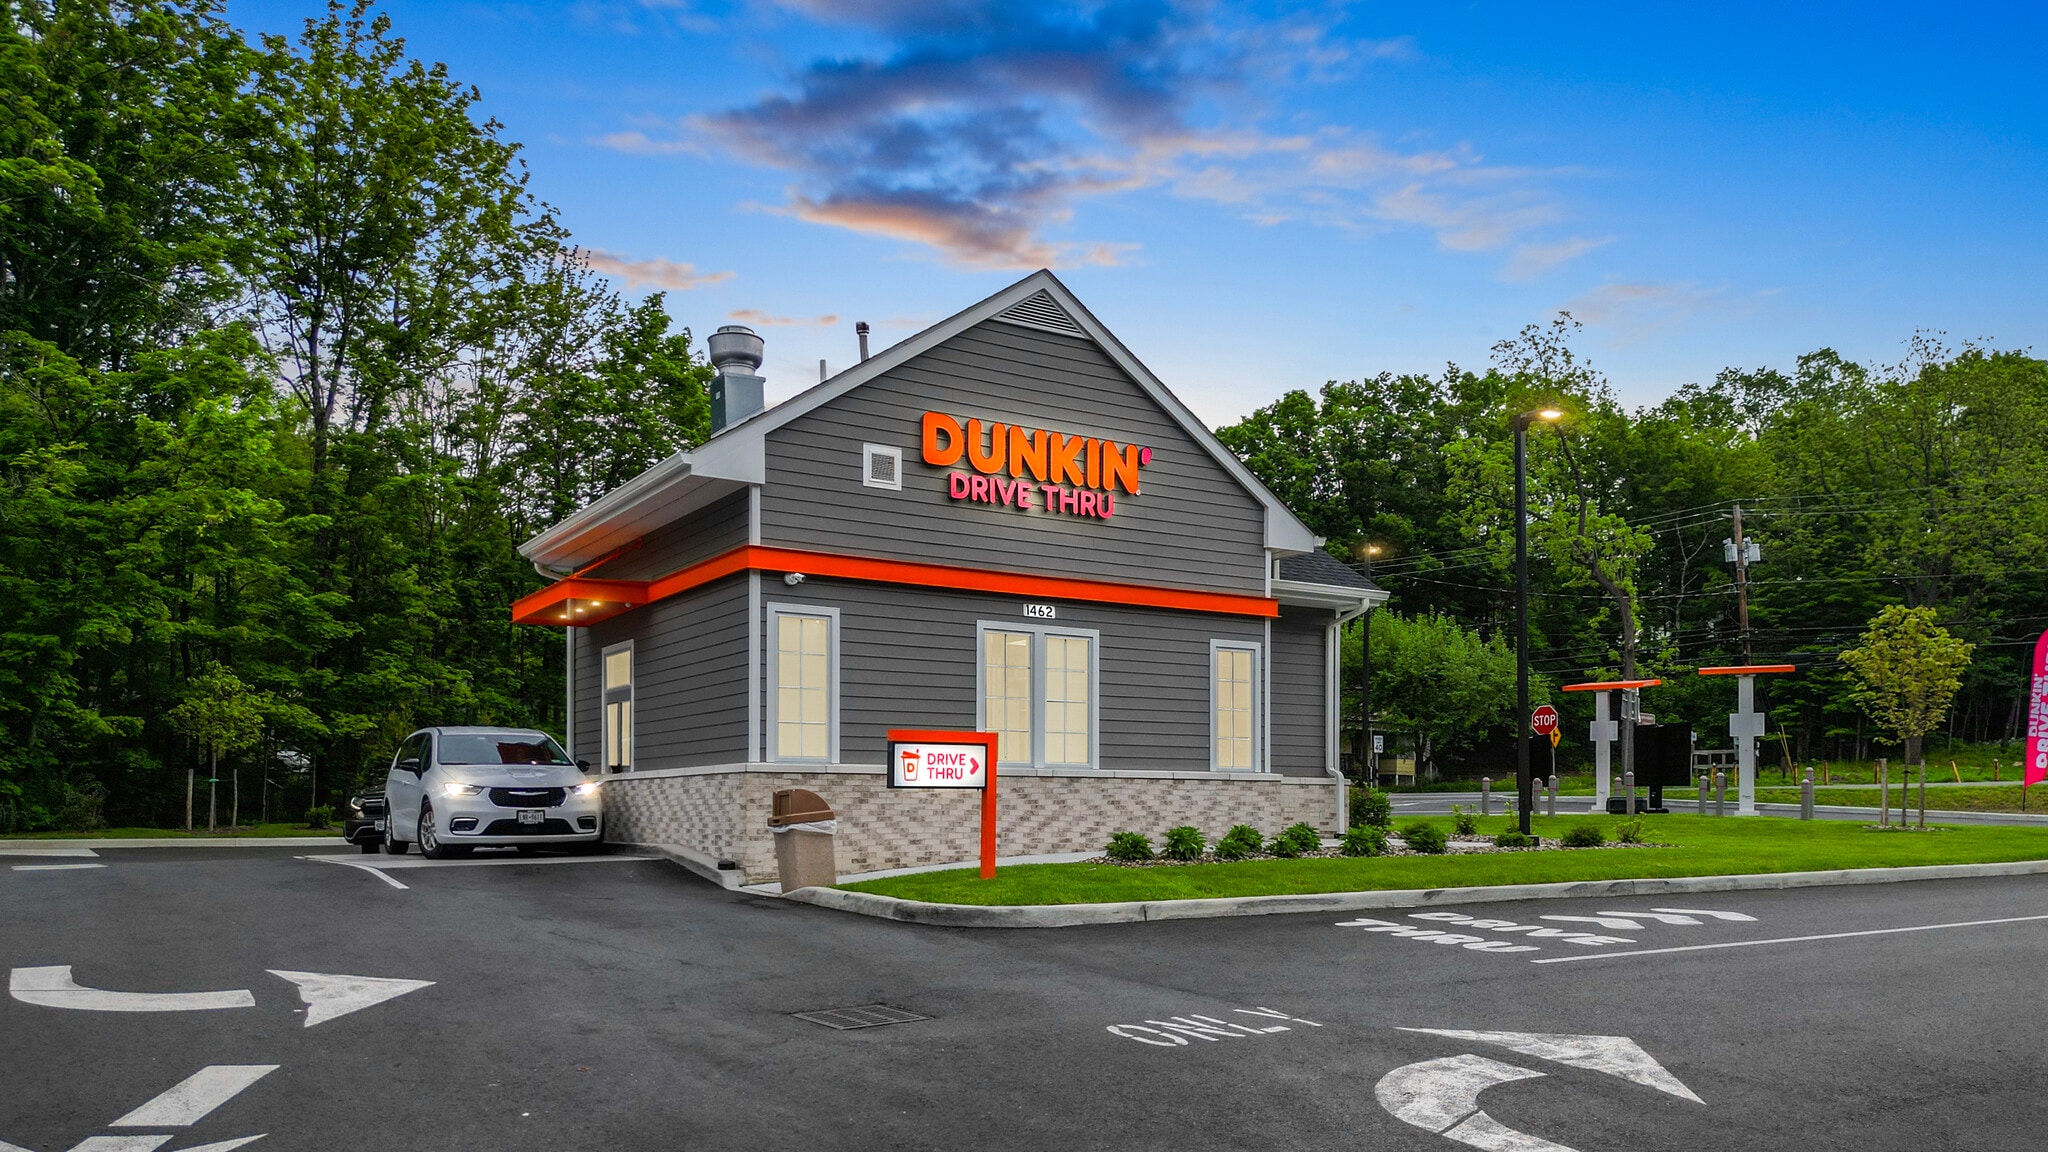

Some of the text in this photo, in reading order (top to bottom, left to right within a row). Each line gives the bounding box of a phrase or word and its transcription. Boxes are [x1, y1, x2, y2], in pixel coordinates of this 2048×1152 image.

[922, 411, 1152, 495] DUNKIN'
[949, 472, 1115, 520] DRIVE THRU
[1025, 604, 1053, 618] 1462
[1533, 714, 1556, 726] STOP
[2028, 673, 2044, 737] DUNKIN'
[927, 753, 966, 766] DRIVE
[1374, 743, 1383, 751] 40
[927, 767, 963, 780] THRU
[1334, 918, 1541, 953] THRU
[1407, 911, 1637, 946] DRIVE
[1106, 1006, 1324, 1047] ONLY
